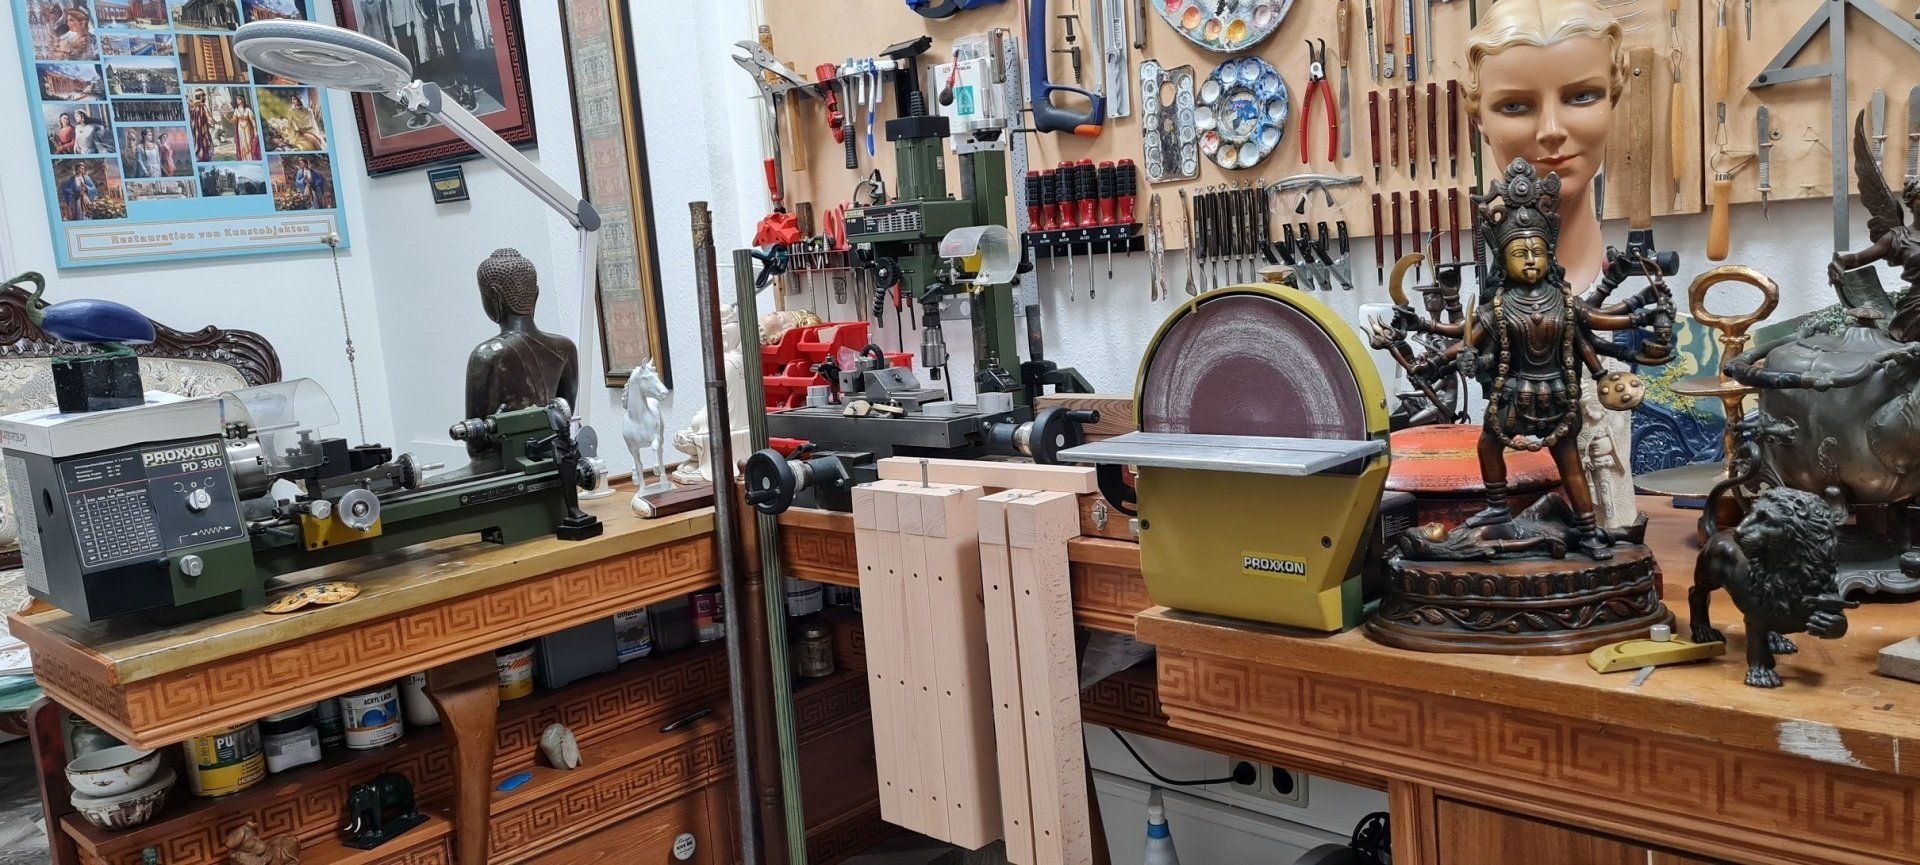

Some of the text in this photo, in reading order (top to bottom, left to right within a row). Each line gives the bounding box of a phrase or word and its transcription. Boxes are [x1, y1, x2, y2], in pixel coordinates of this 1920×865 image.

[111, 225, 310, 244] Restauration von Kunstobjekten
[143, 443, 219, 466] PROXXON
[182, 457, 222, 472] PD 360
[1243, 556, 1305, 576] PROXXON
[363, 692, 392, 706] ACRYL LACK
[216, 735, 234, 750] PU
